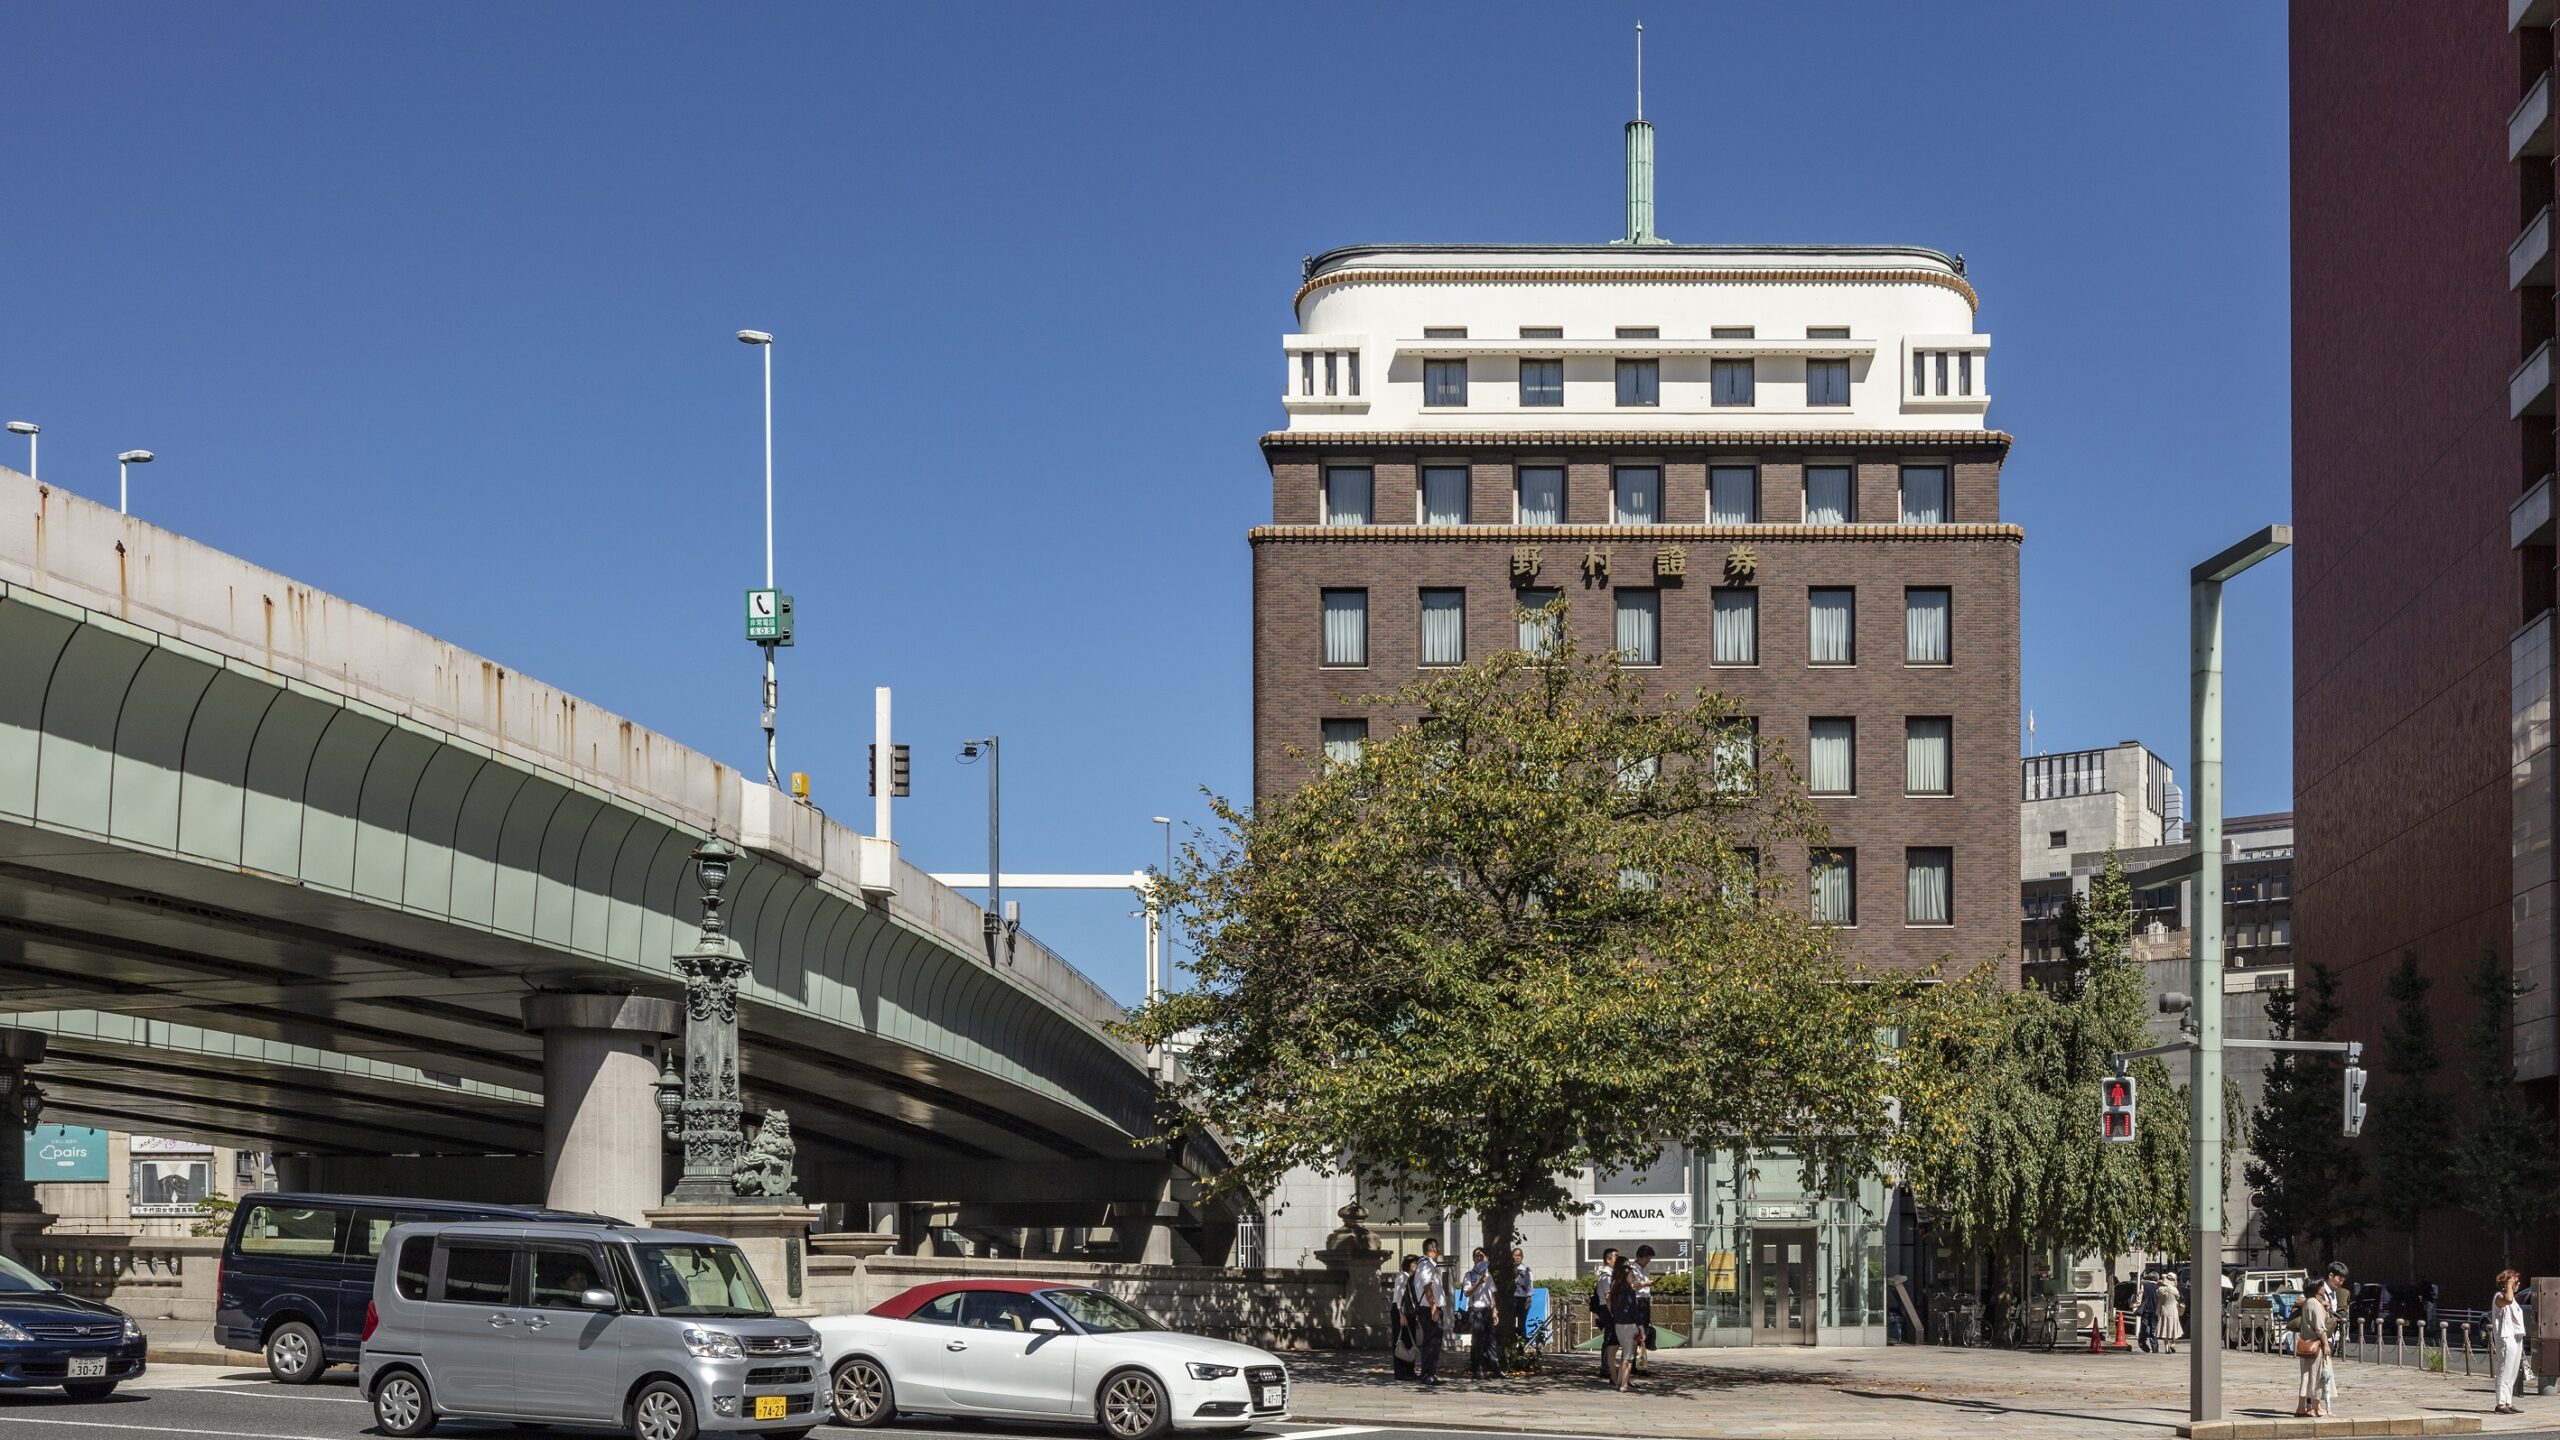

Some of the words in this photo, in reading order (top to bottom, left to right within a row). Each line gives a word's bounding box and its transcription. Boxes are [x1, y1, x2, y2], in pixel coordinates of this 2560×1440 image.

[1513, 545, 1758, 576] 野村證券
[750, 619, 775, 627] 非常電話
[54, 1146, 87, 1159] pairs
[1610, 1209, 1665, 1219] NOMURA
[77, 1365, 104, 1375] 30-27
[763, 1406, 785, 1417] 74-23
